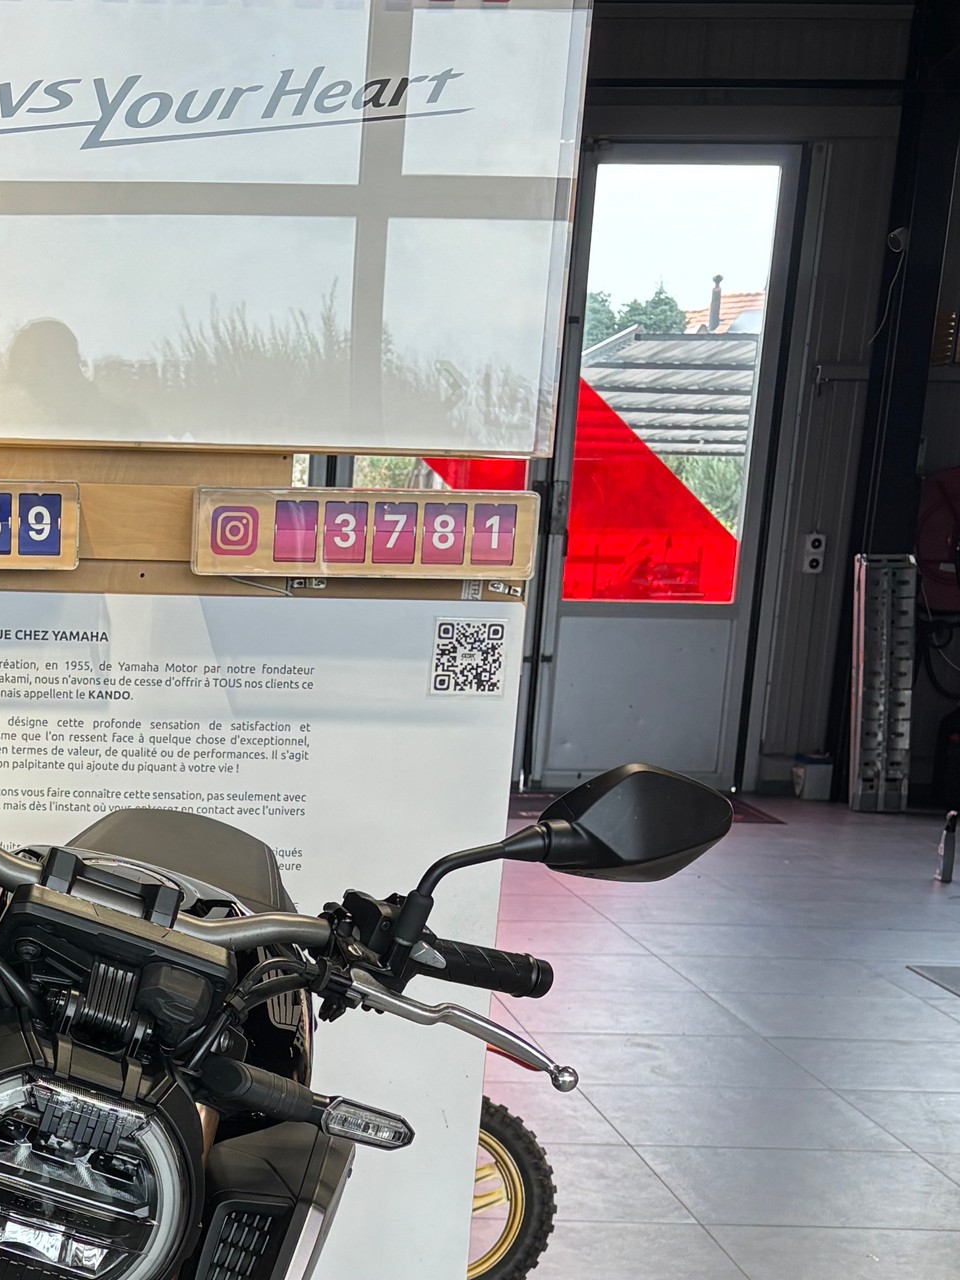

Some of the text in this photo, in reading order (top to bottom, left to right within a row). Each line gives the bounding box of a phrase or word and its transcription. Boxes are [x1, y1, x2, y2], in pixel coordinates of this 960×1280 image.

[80, 74, 266, 150] Your
[261, 66, 466, 121] Heart
[15, 629, 49, 641] CHEZ
[51, 630, 109, 643] YAMAHA
[45, 662, 58, 671] en
[65, 660, 93, 673] 1955,
[99, 660, 112, 672] de
[118, 661, 159, 673] Yamaha
[164, 663, 198, 673] Motor
[203, 665, 222, 676] par
[226, 664, 256, 675] notre
[261, 663, 315, 676] fondateur
[34, 676, 60, 685] nous
[61, 674, 101, 686] n'avons
[103, 677, 116, 686] eu
[118, 675, 132, 687] de
[134, 678, 163, 687] cesse
[164, 676, 202, 688] d'offrir
[204, 677, 210, 688] à
[212, 676, 242, 689] TOUS
[244, 680, 263, 689] nos
[265, 678, 300, 690] clients
[301, 681, 314, 690] ce
[23, 688, 74, 701] appellent
[76, 688, 86, 700] le
[88, 689, 133, 701] KANDO.
[7, 716, 48, 729] désigne
[56, 718, 84, 728] cette
[93, 718, 142, 730] profonde
[150, 720, 200, 731] sensation
[208, 720, 222, 731] de
[230, 720, 291, 732] satisfaction
[299, 723, 311, 733] et
[21, 733, 41, 743] que
[45, 730, 65, 742] l'on
[69, 733, 108, 743] ressent
[111, 732, 134, 744] face
[138, 733, 145, 744] à
[148, 733, 192, 746] quelque
[195, 734, 226, 745] chose
[230, 734, 310, 748] d'exceptionnel,
[11, 745, 48, 756] termes
[51, 745, 65, 756] de
[67, 745, 102, 759] valeur,
[104, 746, 118, 758] de
[121, 747, 158, 759] qualité
[160, 750, 174, 758] ou
[177, 747, 191, 759] de
[193, 748, 268, 761] performances.
[271, 749, 278, 760] Il
[281, 749, 309, 763] s'agit
[12, 758, 65, 771] palpitante
[67, 760, 84, 772] qui
[86, 760, 119, 773] ajoute
[121, 760, 135, 772] du
[137, 761, 177, 774] piquant
[179, 762, 186, 773] à
[188, 763, 216, 773] votre
[218, 763, 234, 774] vie
[20, 789, 45, 798] vous
[46, 787, 71, 798] faire
[72, 788, 122, 799] connaître
[123, 790, 151, 800] cette
[152, 790, 205, 802] sensation,
[206, 793, 225, 803] pas
[226, 791, 281, 802] seulement
[283, 794, 306, 803] avec
[3, 801, 27, 811] mais
[29, 800, 47, 811] dès
[49, 801, 91, 812] l'instant
[93, 802, 107, 813] où
[196, 805, 235, 815] contact
[236, 807, 260, 816] avec
[262, 805, 305, 816] l'univers
